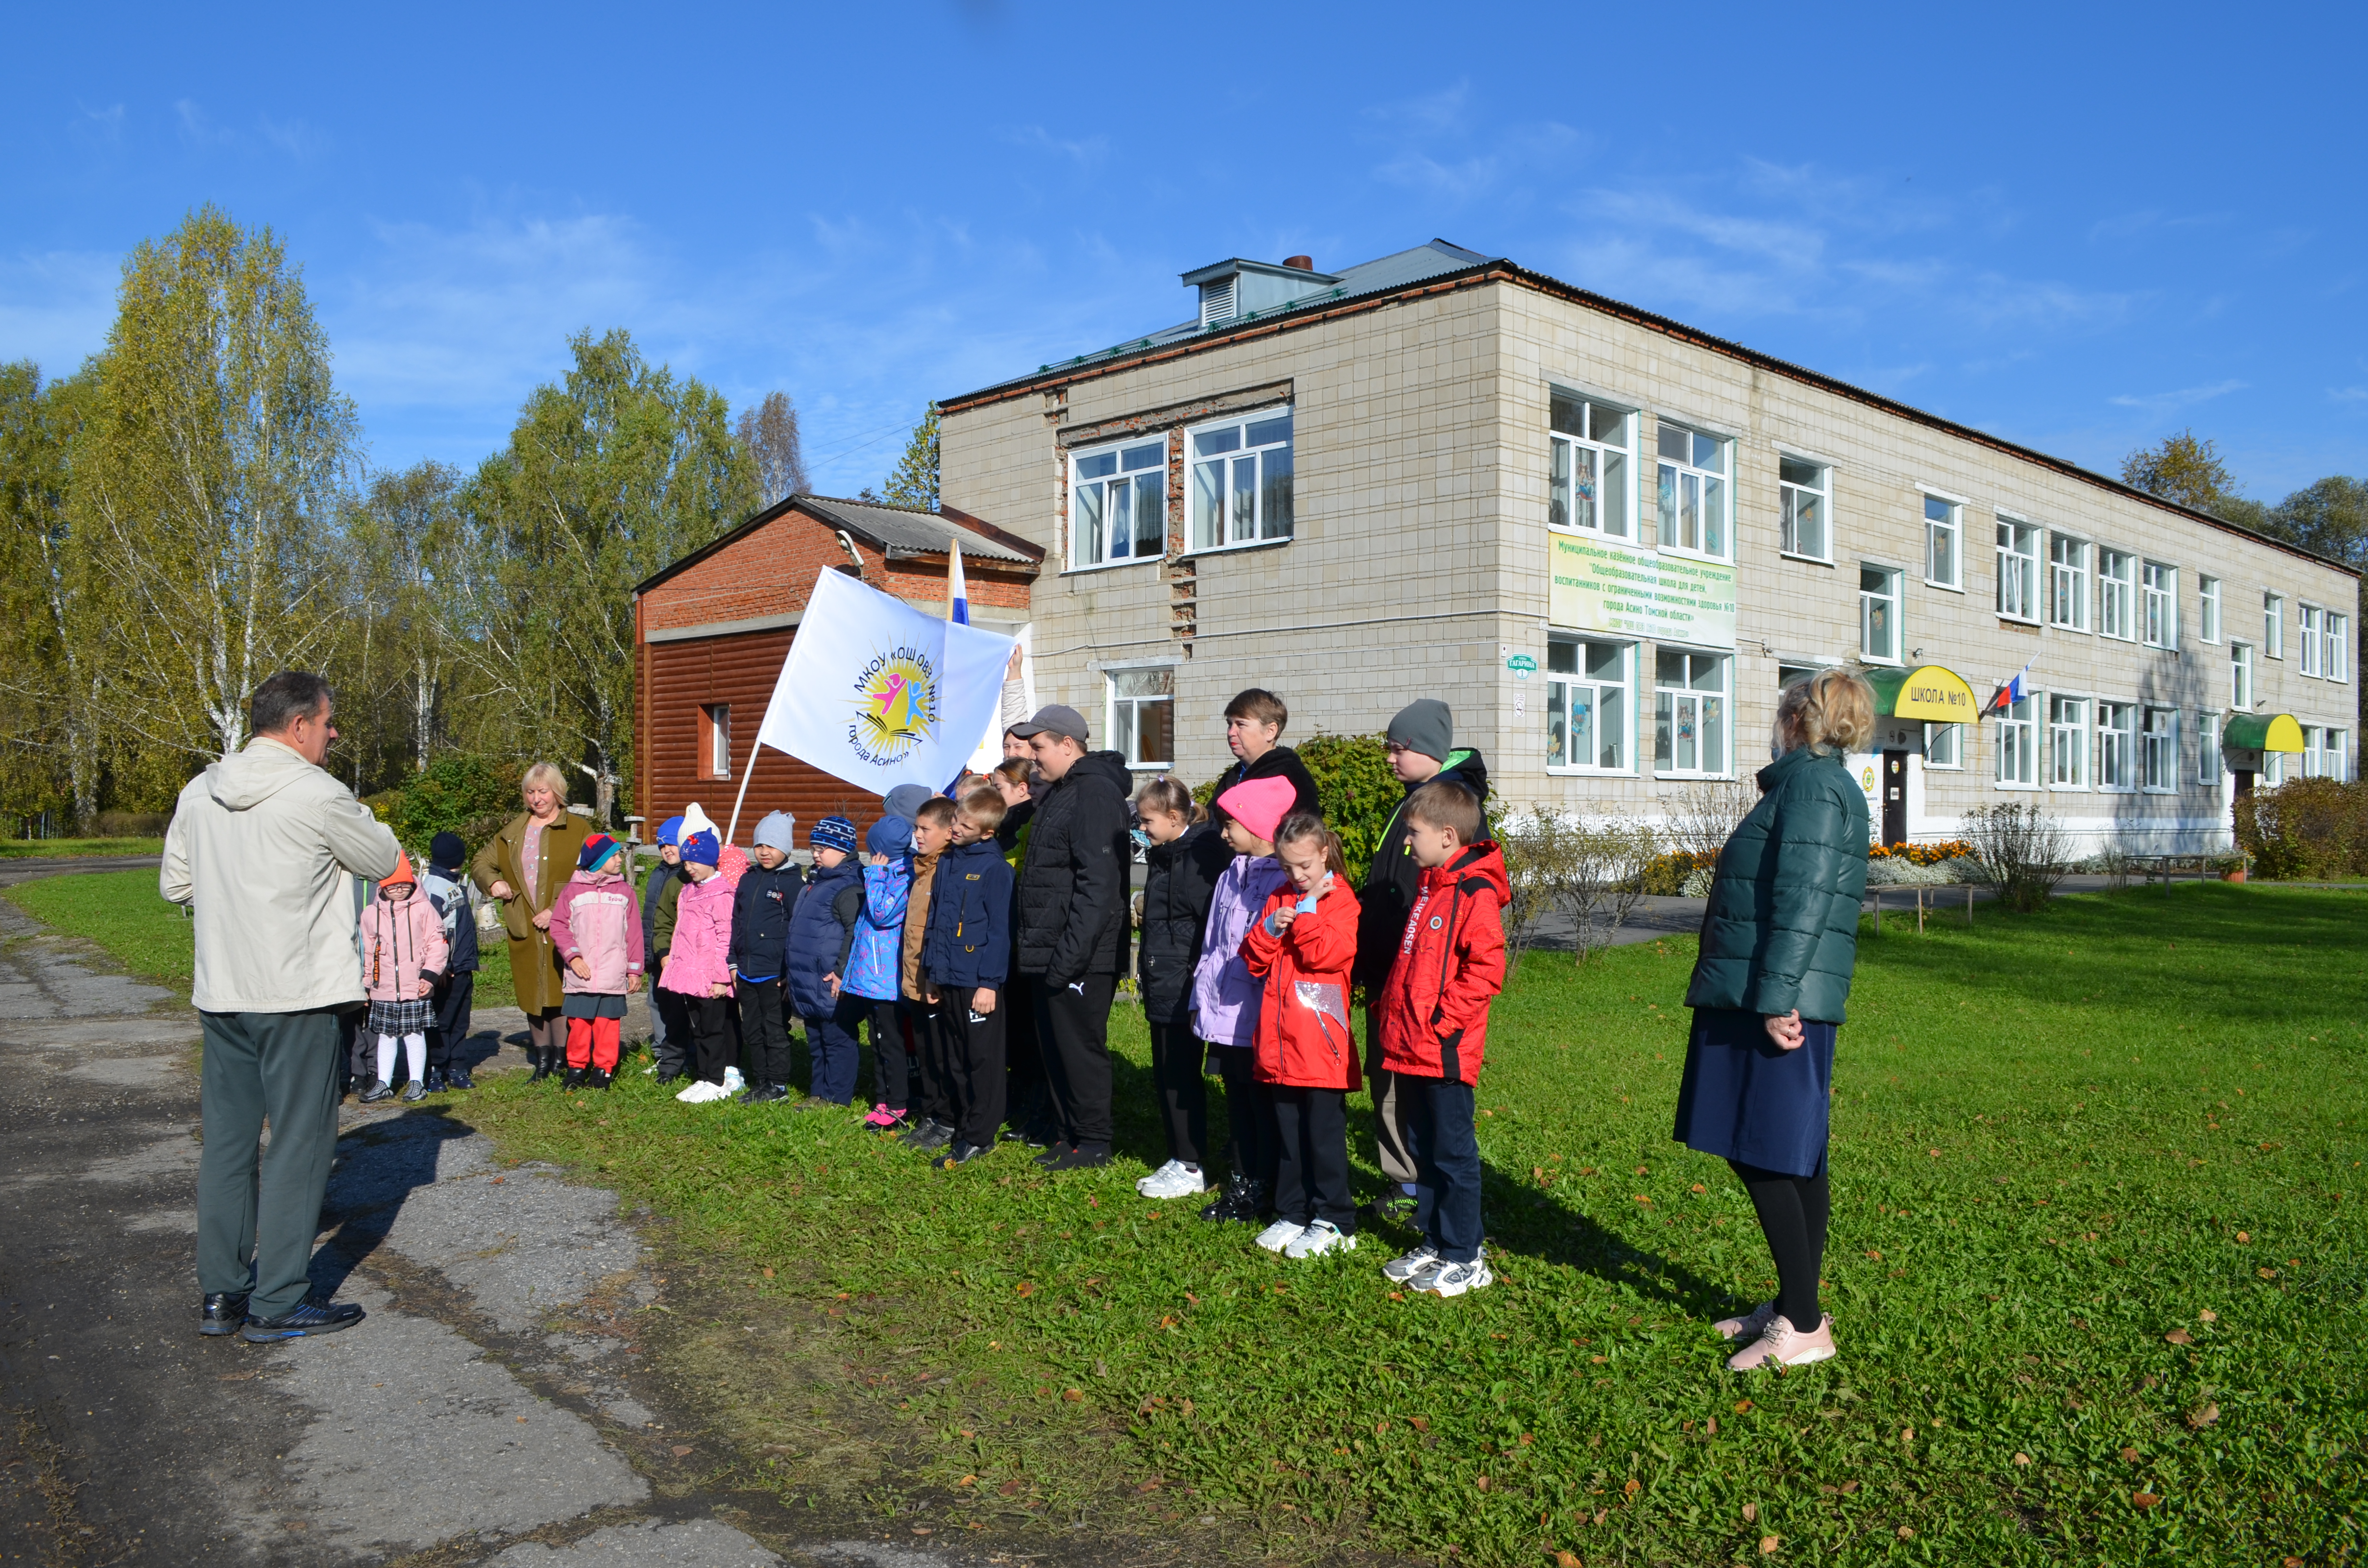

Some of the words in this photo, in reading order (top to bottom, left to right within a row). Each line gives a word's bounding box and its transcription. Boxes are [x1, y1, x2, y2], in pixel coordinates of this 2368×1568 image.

[1558, 540, 1607, 559] Муниципальное
[1610, 551, 1636, 564] казённое
[1638, 556, 1698, 576] общеобразовательное
[1700, 569, 1731, 582] учреждение
[1554, 576, 1600, 591] воспитанников
[1602, 583, 1605, 592] с
[1608, 584, 1653, 600] ограниченными
[1654, 592, 1696, 607] возможностями
[1698, 600, 1722, 611] здоровья
[1724, 602, 1735, 612] №10
[1659, 577, 1677, 588] школа
[1678, 581, 1688, 590] для
[1690, 583, 1707, 594] детей,
[1603, 600, 1623, 612] города
[1626, 602, 1642, 614] Асино
[1644, 605, 1667, 618] Томской
[1670, 610, 1694, 622] области»
[1509, 660, 1535, 669] ГАГАРИНА
[853, 652, 886, 692] МКОУ
[890, 647, 916, 661] «ОШ
[917, 654, 932, 679] ОВЗ
[928, 684, 936, 723] №10
[1911, 686, 1944, 704] ШКОЛА
[1948, 691, 1966, 706] №10
[848, 724, 870, 761] города
[870, 751, 909, 766] Асино»
[1404, 886, 1429, 955] WEIKEAOSEN
